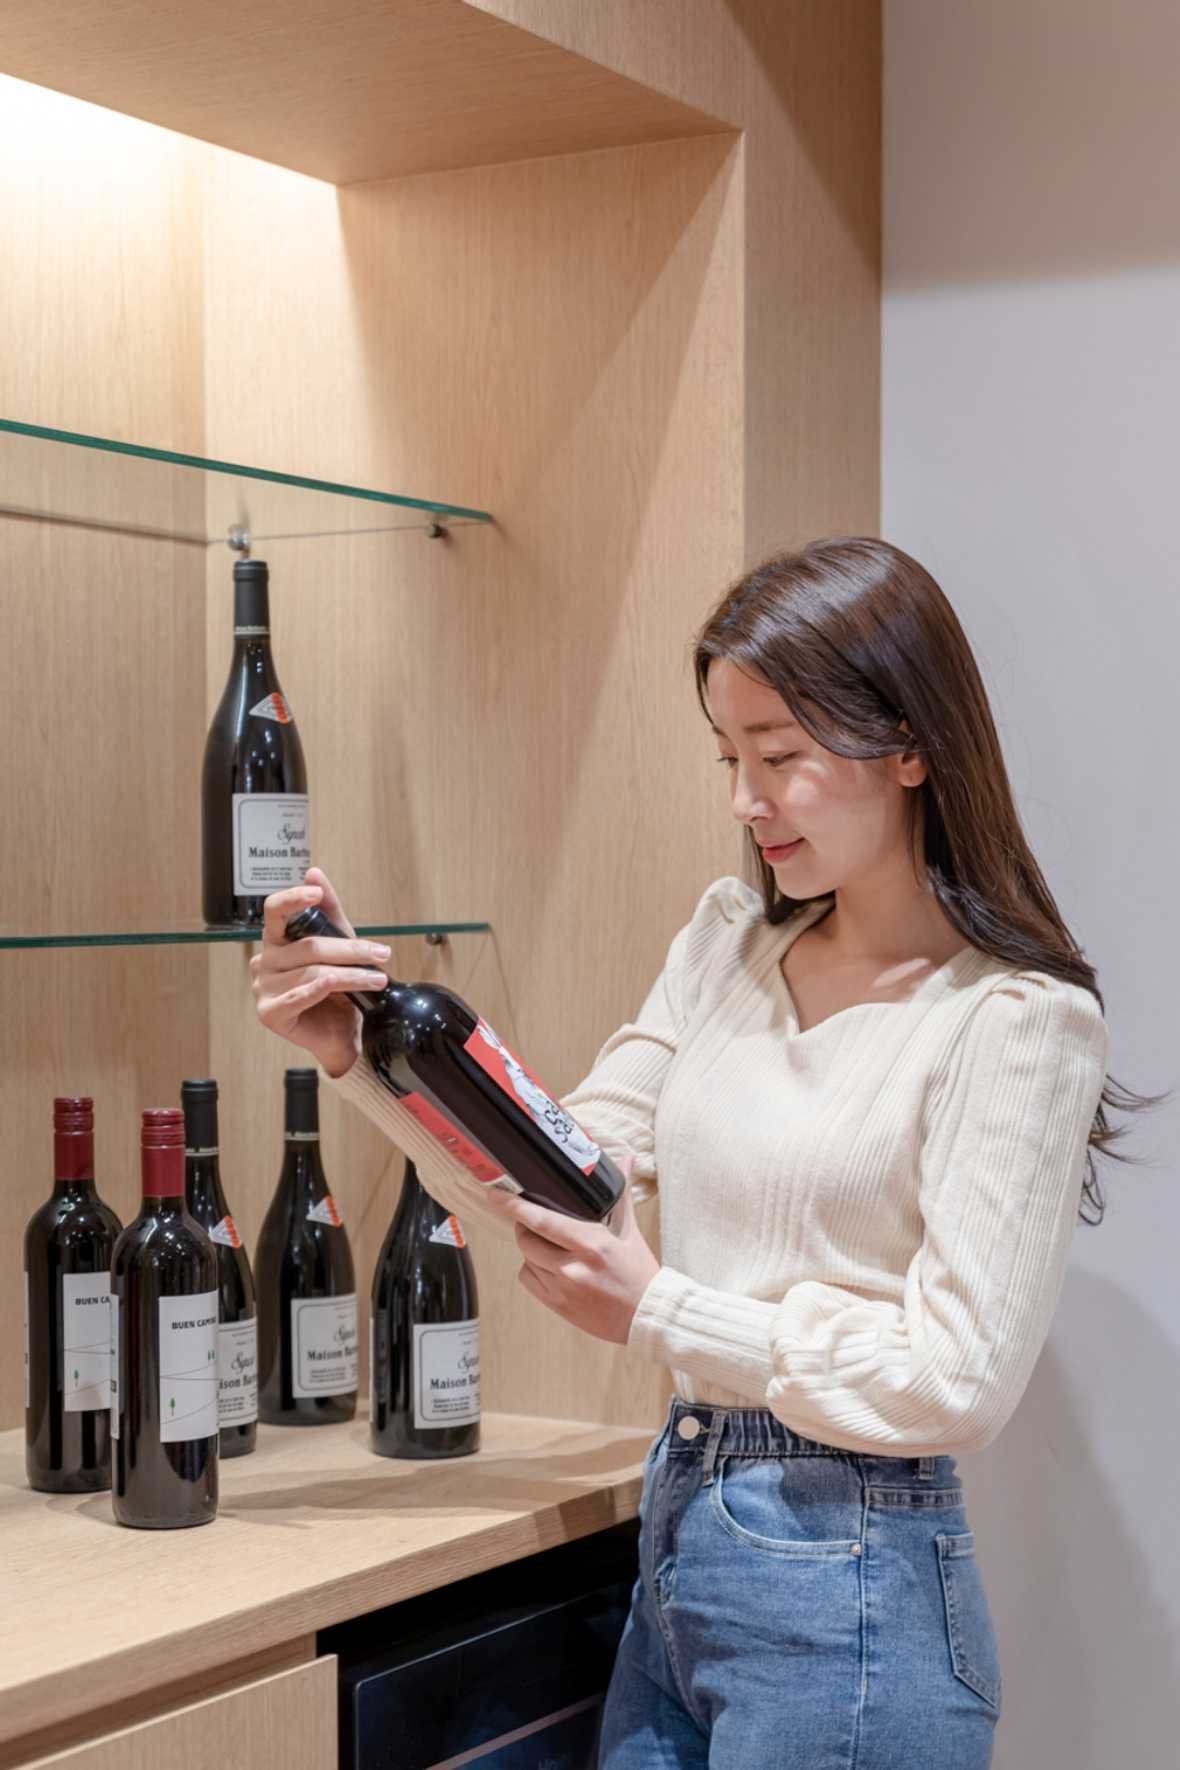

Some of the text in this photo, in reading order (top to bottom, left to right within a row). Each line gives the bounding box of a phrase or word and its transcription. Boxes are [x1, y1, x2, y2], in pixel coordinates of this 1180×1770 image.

[248, 846, 288, 858] Maison
[75, 1296, 98, 1306] BUEN
[171, 1320, 195, 1330] BUEN
